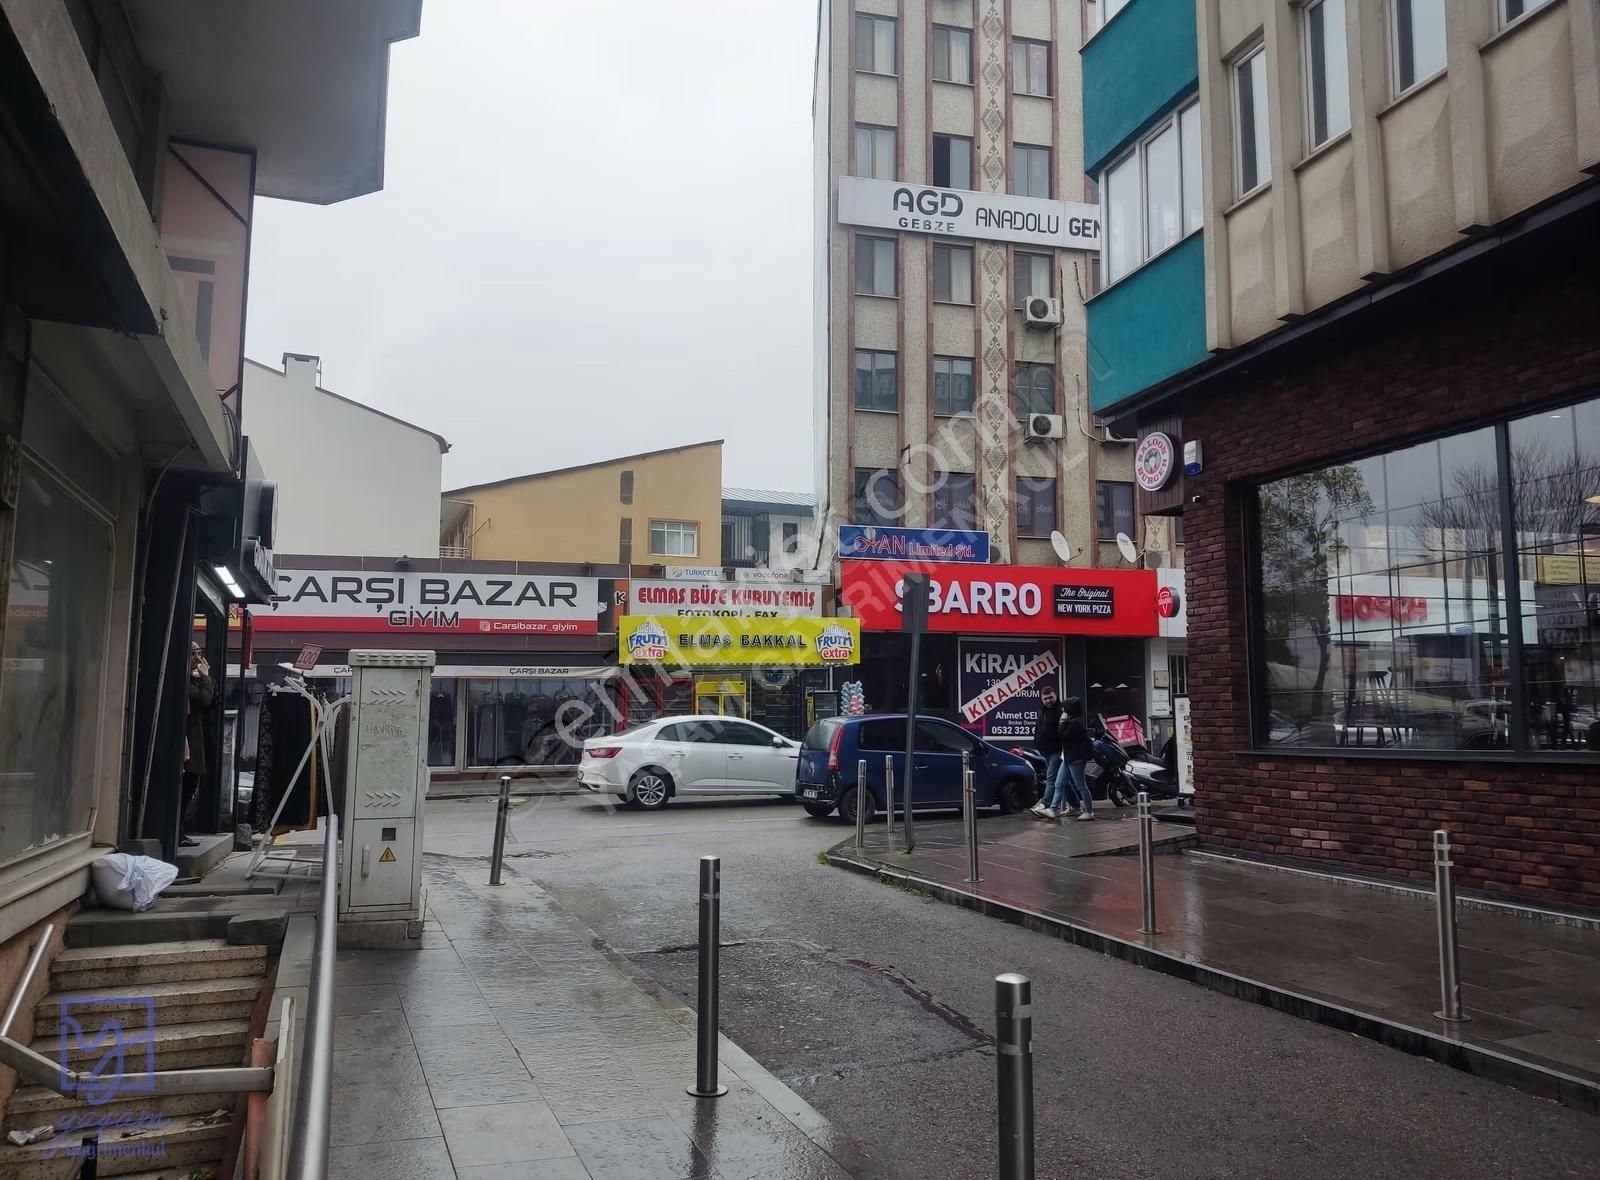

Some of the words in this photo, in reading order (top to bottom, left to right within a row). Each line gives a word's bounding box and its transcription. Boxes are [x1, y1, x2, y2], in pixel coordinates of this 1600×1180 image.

[893, 187, 963, 217] AGD
[899, 217, 955, 233] GEBZE
[975, 207, 1059, 235] ANADOLU
[909, 542, 953, 557] Limited
[420, 579, 578, 608] BAZAR
[638, 587, 686, 605] ELMAS
[690, 585, 727, 605] BÜFE
[731, 588, 816, 610] KURUYEMİŞ
[1077, 588, 1110, 600] Original
[1058, 603, 1073, 613] NEW
[1074, 604, 1091, 614] YORK
[1092, 605, 1112, 615] PIZZA
[389, 606, 460, 628] GİYİM
[493, 621, 578, 633] Carsibazar_giyim
[679, 633, 732, 647] ELMAS
[741, 634, 807, 647] BAKKAL
[635, 647, 662, 658] extra
[823, 648, 848, 659] extra
[509, 667, 536, 676] ÇARŞI
[968, 656, 1055, 719] KİRALANDI
[995, 711, 1022, 720] Ahmet
[991, 726, 1013, 734] 0532
[1014, 726, 1030, 734] 323
